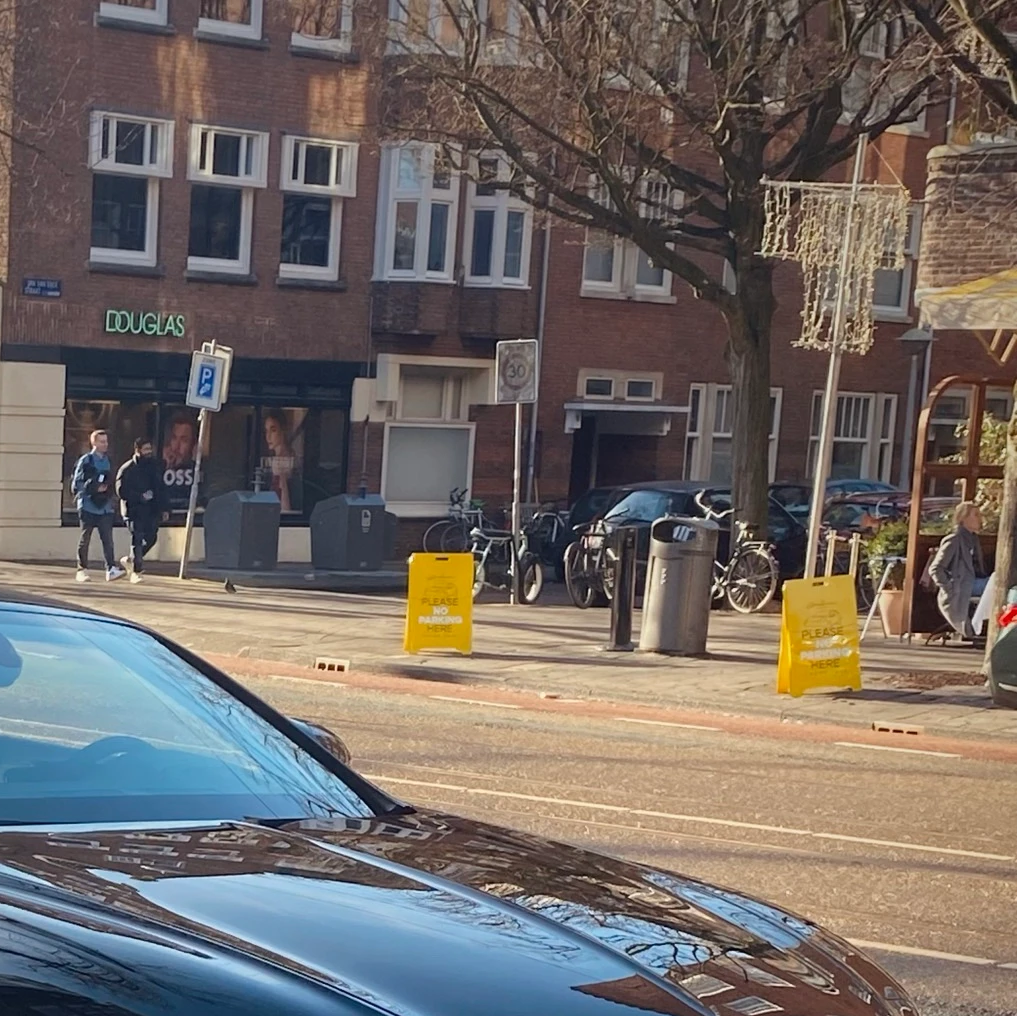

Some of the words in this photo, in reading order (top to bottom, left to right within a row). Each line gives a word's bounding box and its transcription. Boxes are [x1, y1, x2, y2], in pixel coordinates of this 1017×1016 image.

[105, 310, 185, 337] DOUGLAS
[202, 368, 213, 384] P
[507, 364, 526, 378] 30
[163, 469, 193, 486] OSS
[421, 598, 459, 606] PLEASE
[432, 606, 449, 615] NO
[418, 615, 463, 625] PARKING
[427, 625, 453, 633] HERE
[801, 626, 844, 639] PLEASE
[810, 659, 841, 669] HERE
